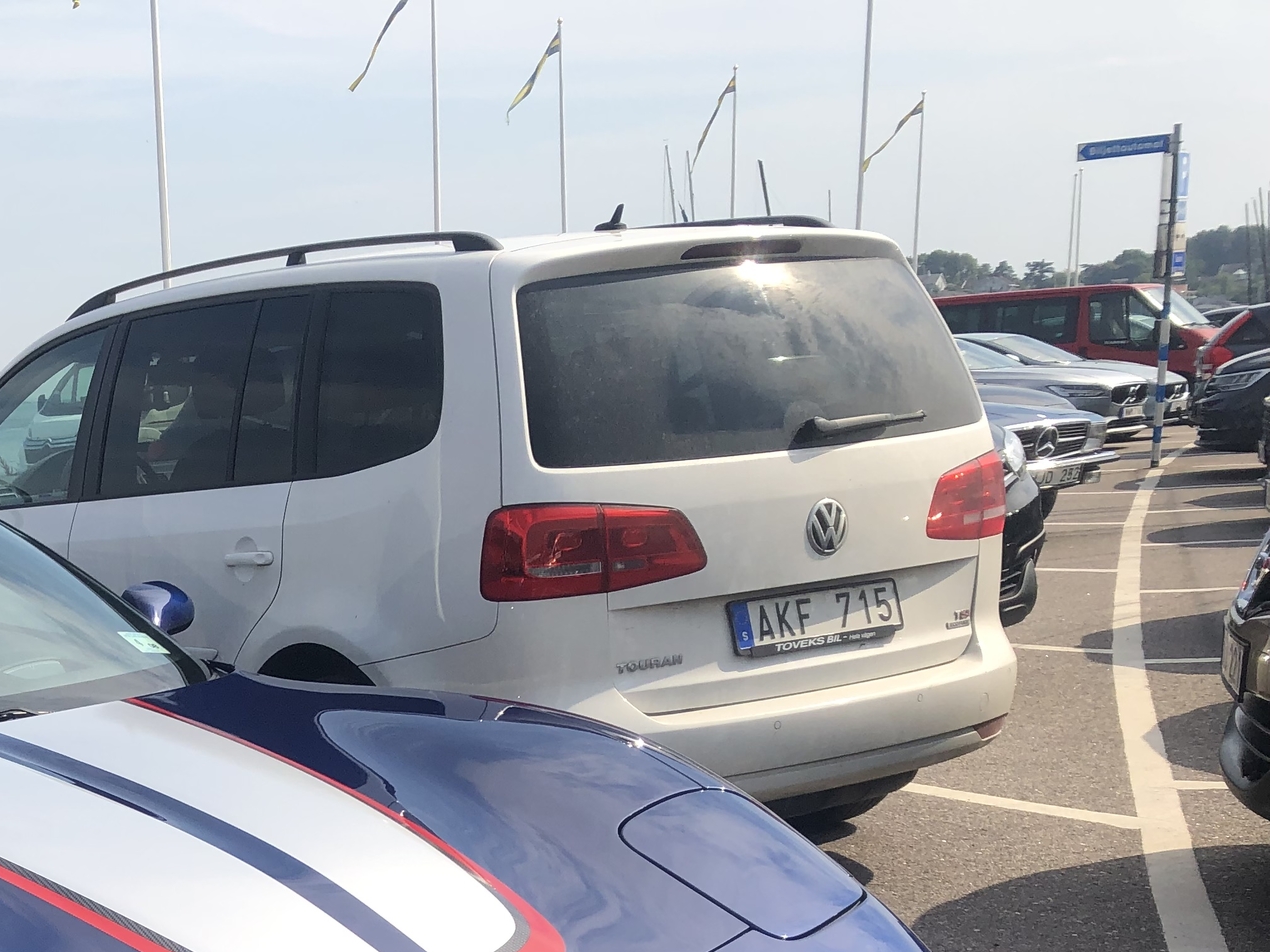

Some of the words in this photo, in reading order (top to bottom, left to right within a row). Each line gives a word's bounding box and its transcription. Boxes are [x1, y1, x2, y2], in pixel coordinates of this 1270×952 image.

[759, 598, 811, 641] AKF
[835, 587, 892, 628] 715
[741, 631, 749, 641] S
[775, 635, 825, 651] TOVEKS
[616, 654, 683, 674] TOURAN
